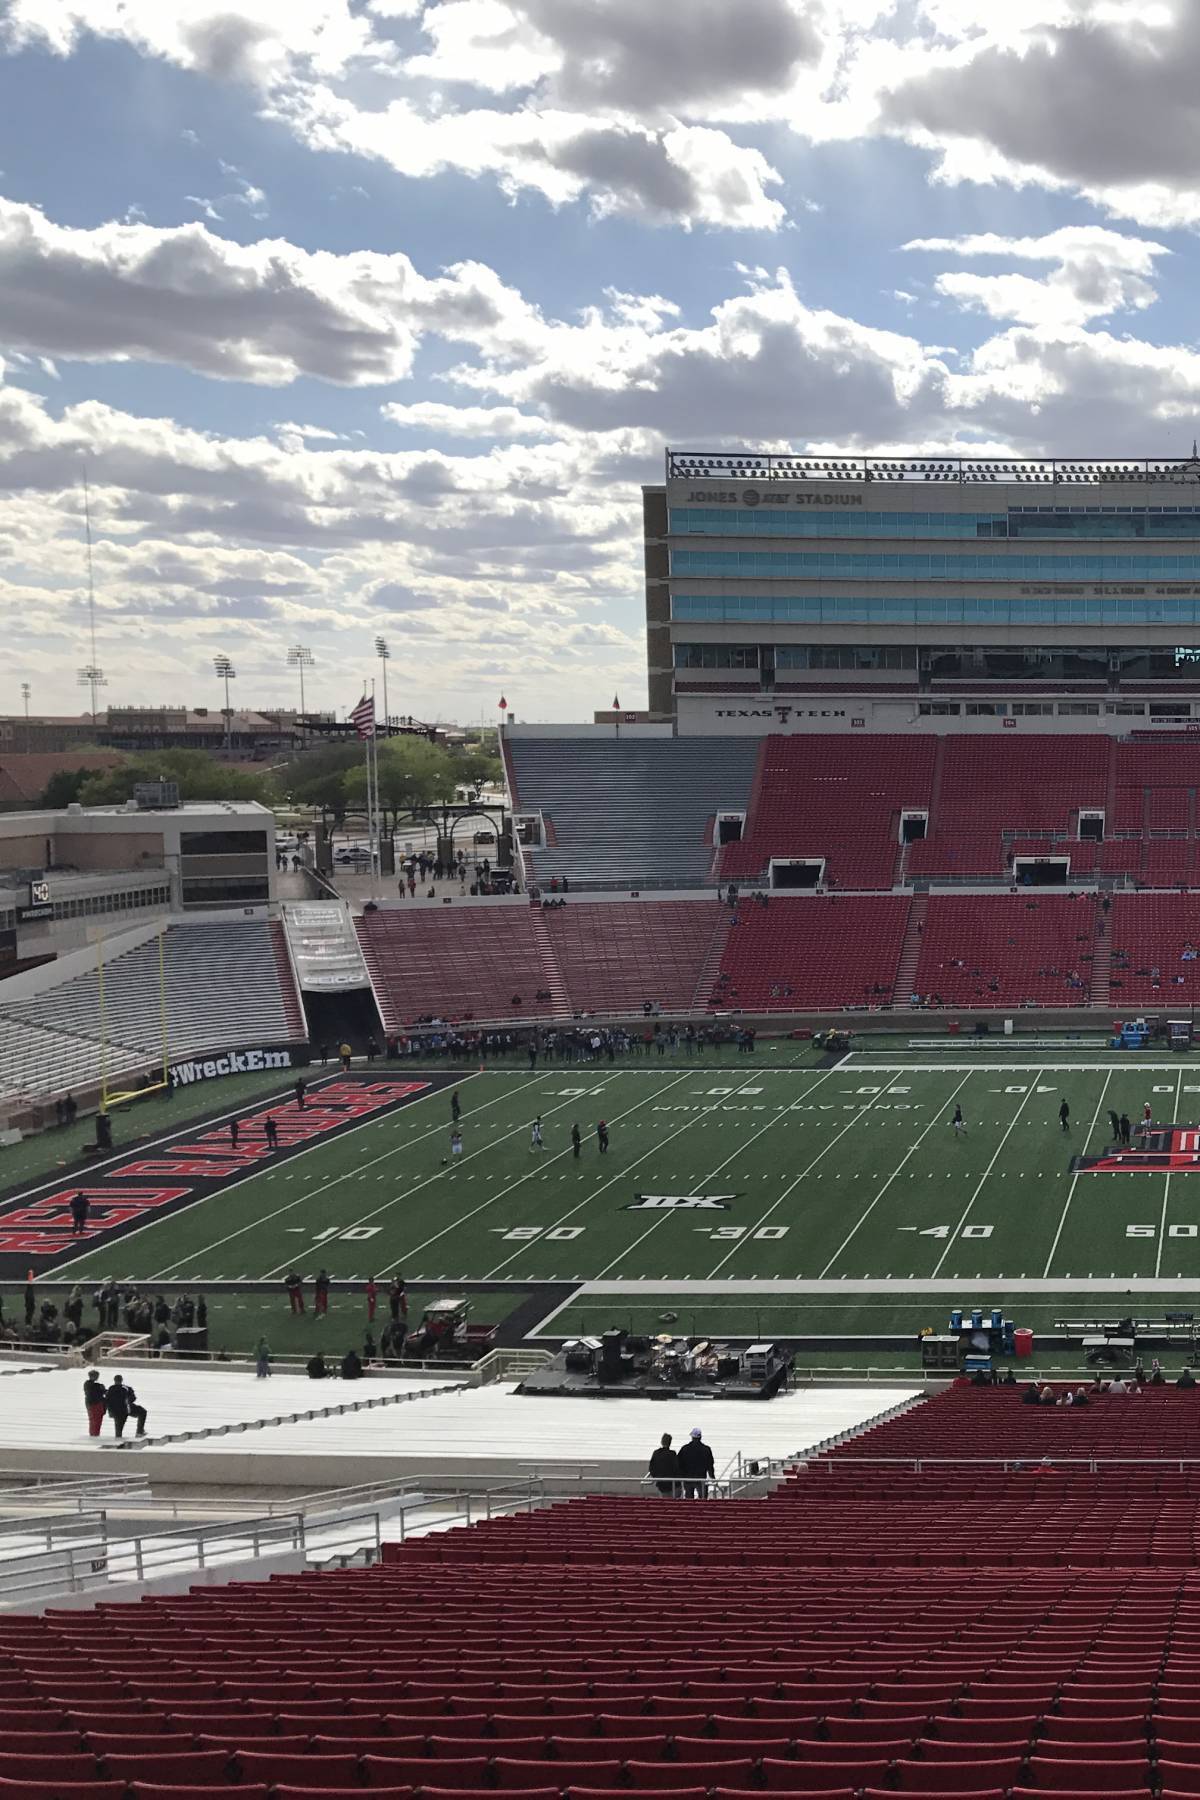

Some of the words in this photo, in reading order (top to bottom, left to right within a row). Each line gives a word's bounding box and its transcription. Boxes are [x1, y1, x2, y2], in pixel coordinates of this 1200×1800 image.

[687, 491, 737, 504] JONES
[795, 493, 862, 505] STADIUM
[33, 883, 49, 901] 40
[1004, 1085, 1058, 1094] 40
[104, 1081, 434, 1177] RAIDERS
[311, 1227, 384, 1240] 10
[502, 1226, 586, 1240] 20
[709, 1226, 791, 1240] 30
[919, 1225, 995, 1238] 40
[1125, 1224, 1198, 1237] 50
